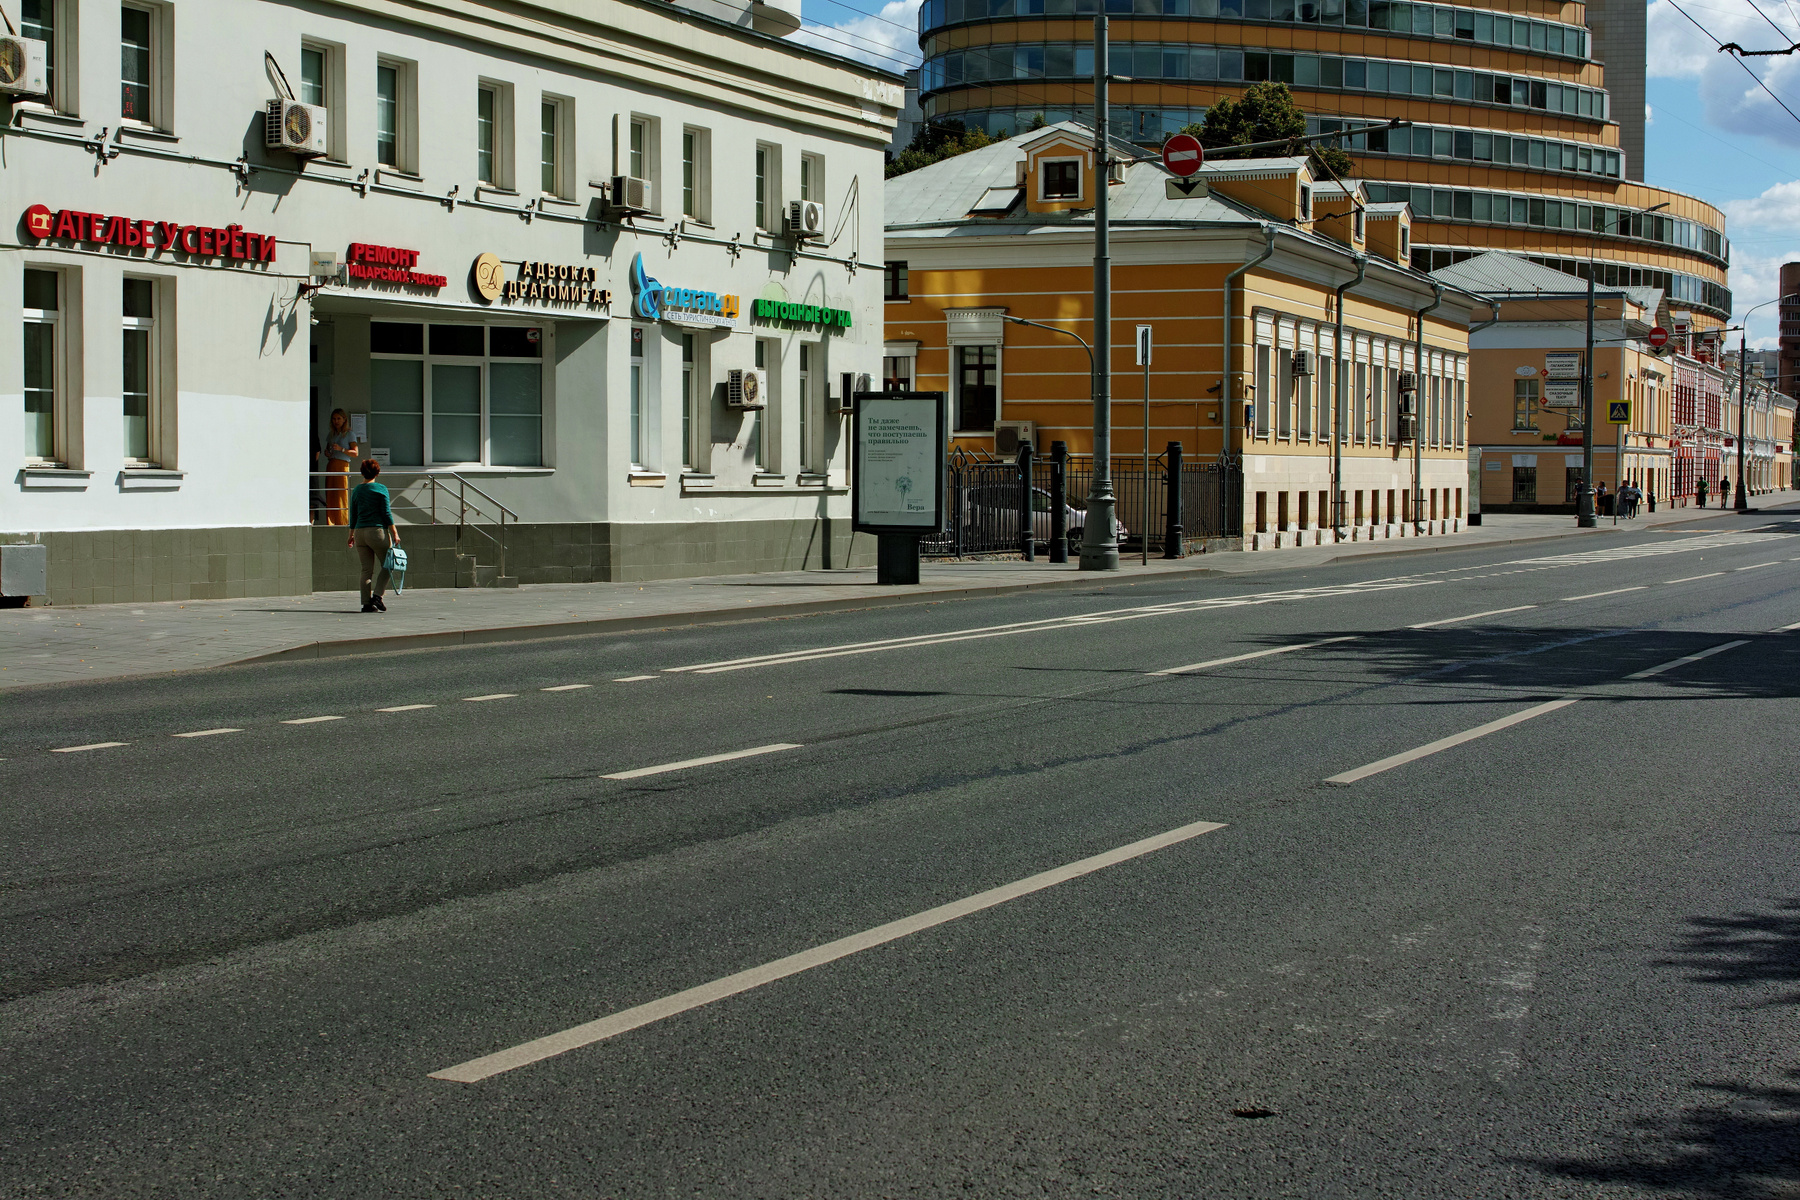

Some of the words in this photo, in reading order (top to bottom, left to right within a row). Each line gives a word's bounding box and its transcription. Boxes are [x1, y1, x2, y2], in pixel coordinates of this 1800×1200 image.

[54, 209, 155, 249] АТЕЛЬЕ
[157, 221, 178, 251] У
[180, 224, 276, 263] СЕРЁГИ
[351, 243, 420, 268] РЕМОНТ
[411, 272, 447, 288] ЧАСОВ
[522, 260, 598, 283] АДВОКАТ
[508, 280, 589, 302] ДРАГОМИР
[666, 311, 682, 320] СЕТЬ
[757, 299, 821, 323] ВЫГОДНЫЕ
[822, 306, 852, 327] ОКНА
[907, 503, 925, 512] Вера
